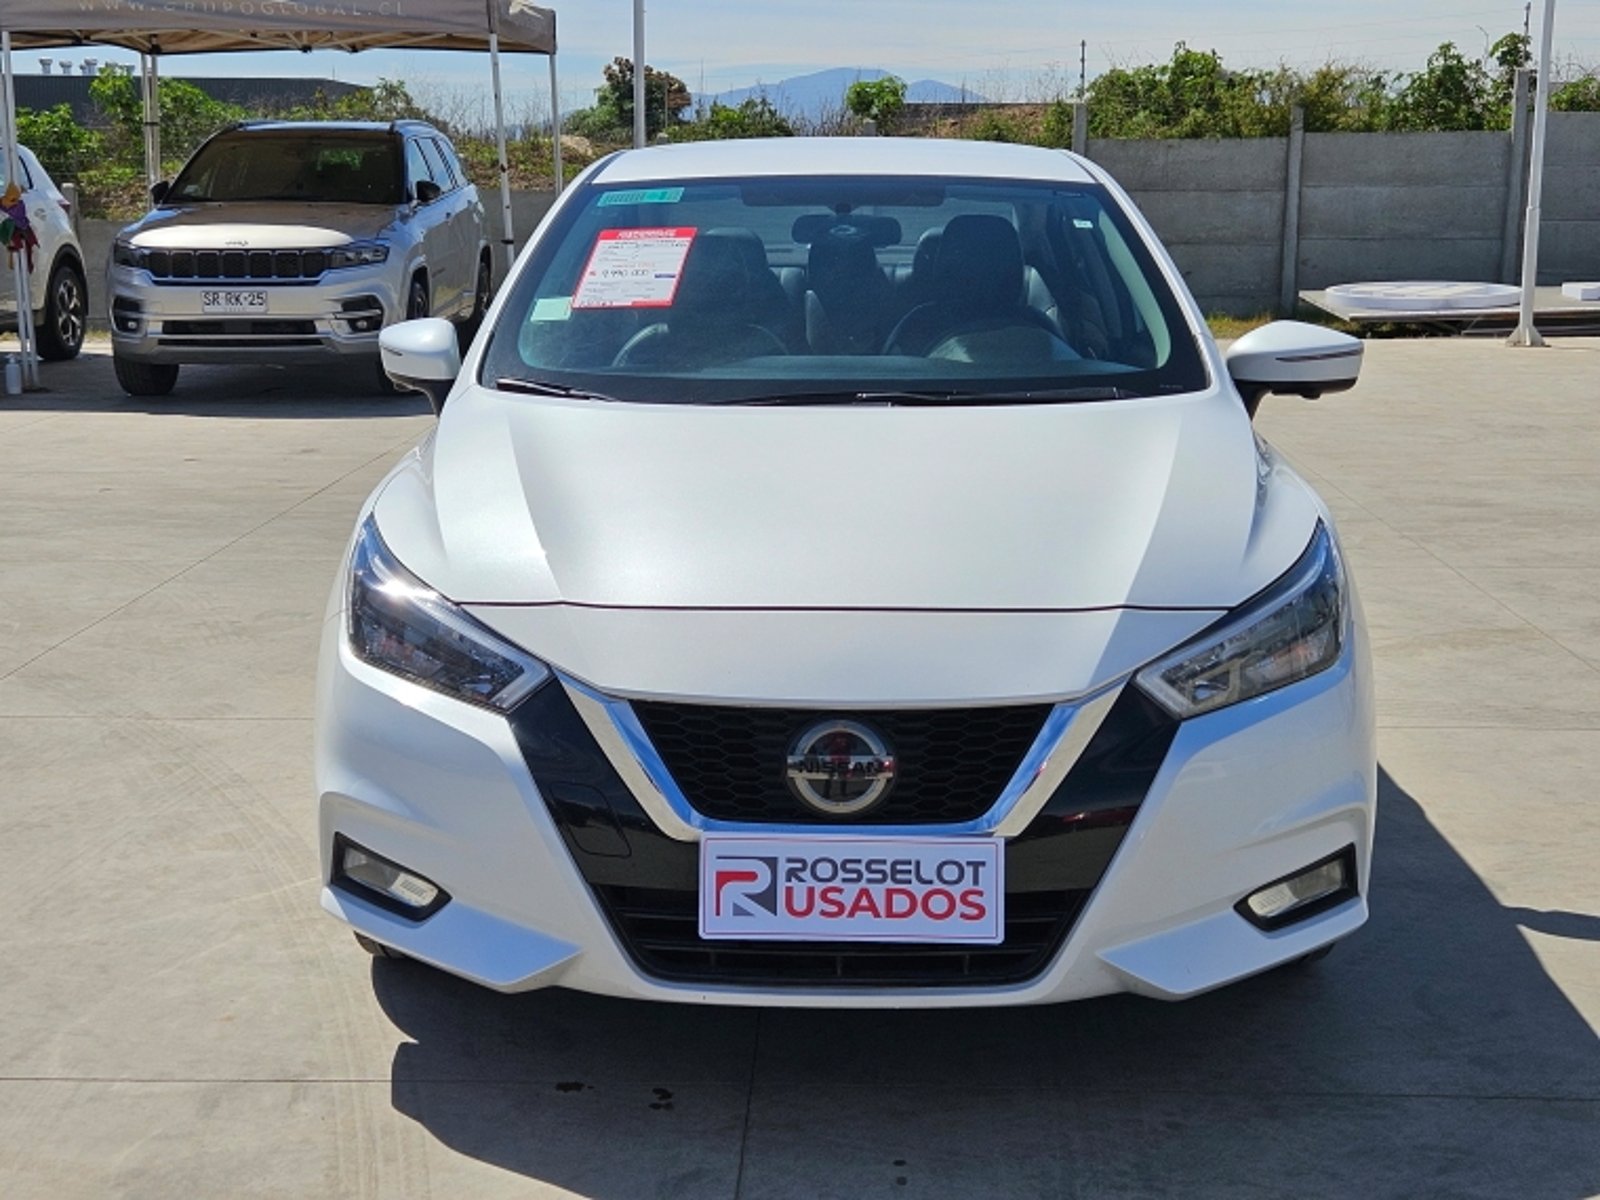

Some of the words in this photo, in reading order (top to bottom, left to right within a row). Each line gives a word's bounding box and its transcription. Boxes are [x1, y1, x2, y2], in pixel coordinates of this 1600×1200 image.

[798, 759, 881, 774] NISSAN
[785, 857, 987, 886] ROSSELOT
[785, 885, 987, 921] USADOS
